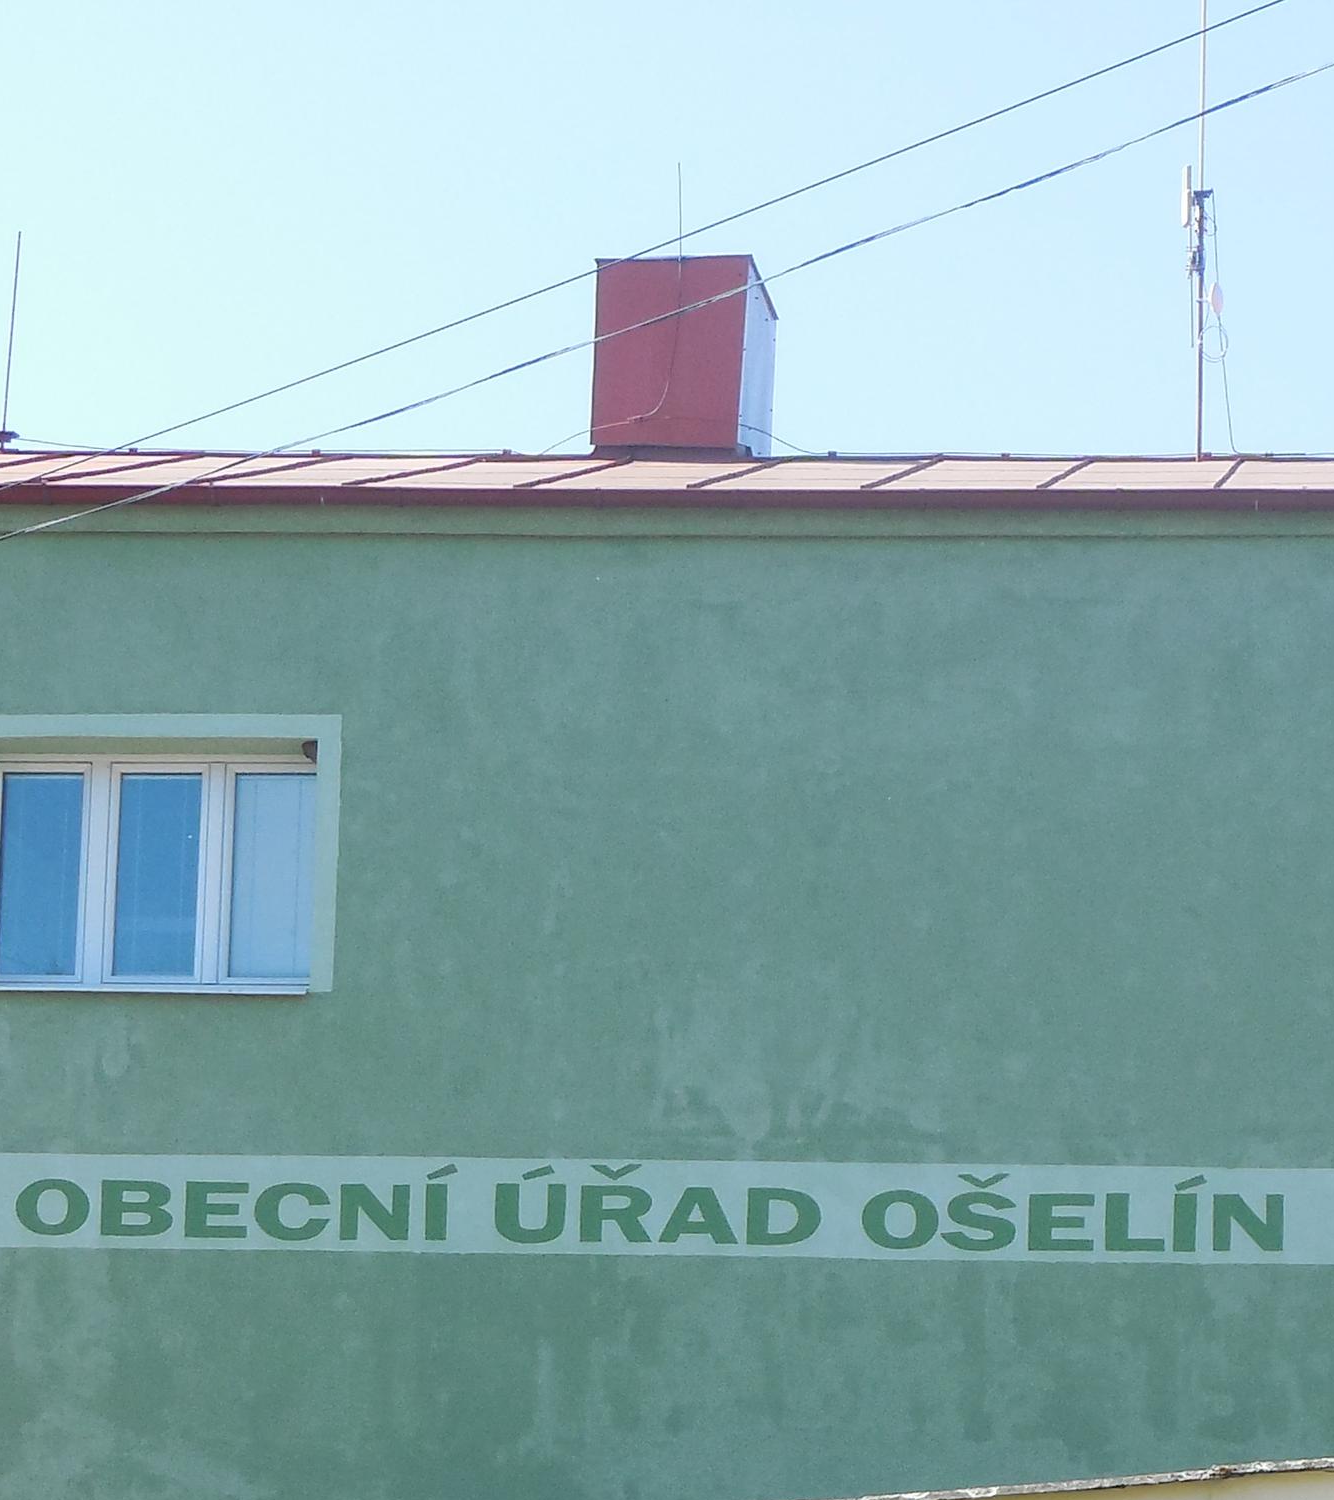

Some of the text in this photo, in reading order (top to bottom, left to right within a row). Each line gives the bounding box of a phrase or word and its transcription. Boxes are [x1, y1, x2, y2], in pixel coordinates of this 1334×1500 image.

[14, 1163, 1285, 1253] OBECNÍ ÚŘAD OŠELÍN
